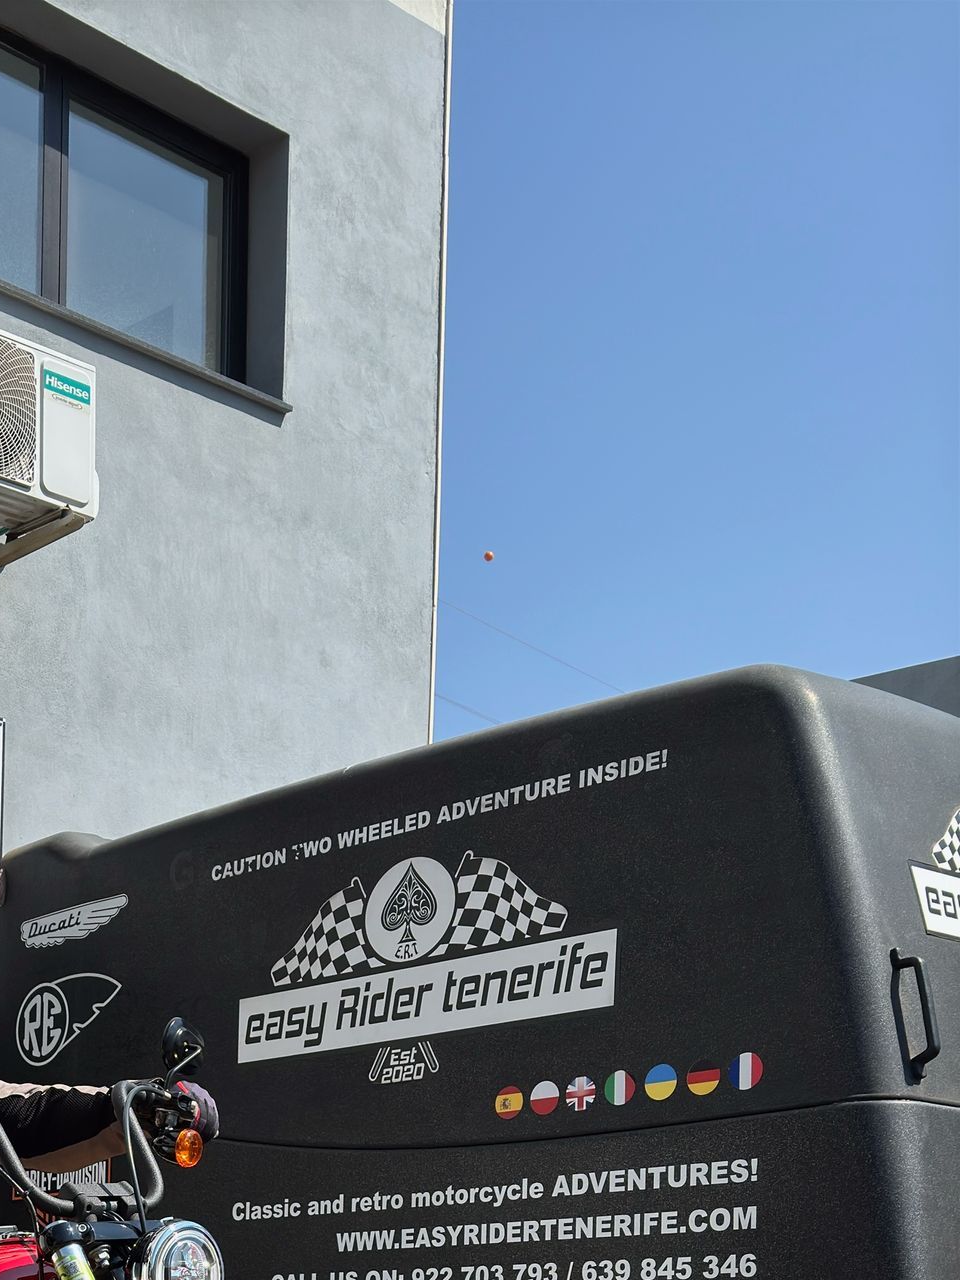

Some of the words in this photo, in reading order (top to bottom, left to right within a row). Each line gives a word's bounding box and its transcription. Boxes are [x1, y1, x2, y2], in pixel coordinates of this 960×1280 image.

[45, 374, 89, 400] Hisense
[211, 848, 287, 882] CAUTION
[337, 810, 431, 848] WHEELED
[436, 773, 571, 824] ADVENTURE
[578, 749, 669, 788] INSIDE!
[925, 886, 960, 920] ea
[28, 911, 81, 939] Ducati
[394, 942, 418, 960] E.R.T
[244, 1000, 327, 1048] easy
[337, 980, 433, 1031] Rider
[441, 941, 609, 1012] tenerife
[23, 992, 62, 1057] RE
[389, 1046, 417, 1068] Est
[381, 1063, 426, 1084] 2020
[232, 1196, 301, 1221] Classic
[307, 1193, 344, 1216] and
[351, 1190, 404, 1211] retro
[411, 1177, 544, 1210] motorcycle
[551, 1158, 758, 1197] ADVENTURES!
[336, 1206, 757, 1252] WWW.EASYRIDERTENERIFE.COM
[702, 1253, 757, 1280] 346
